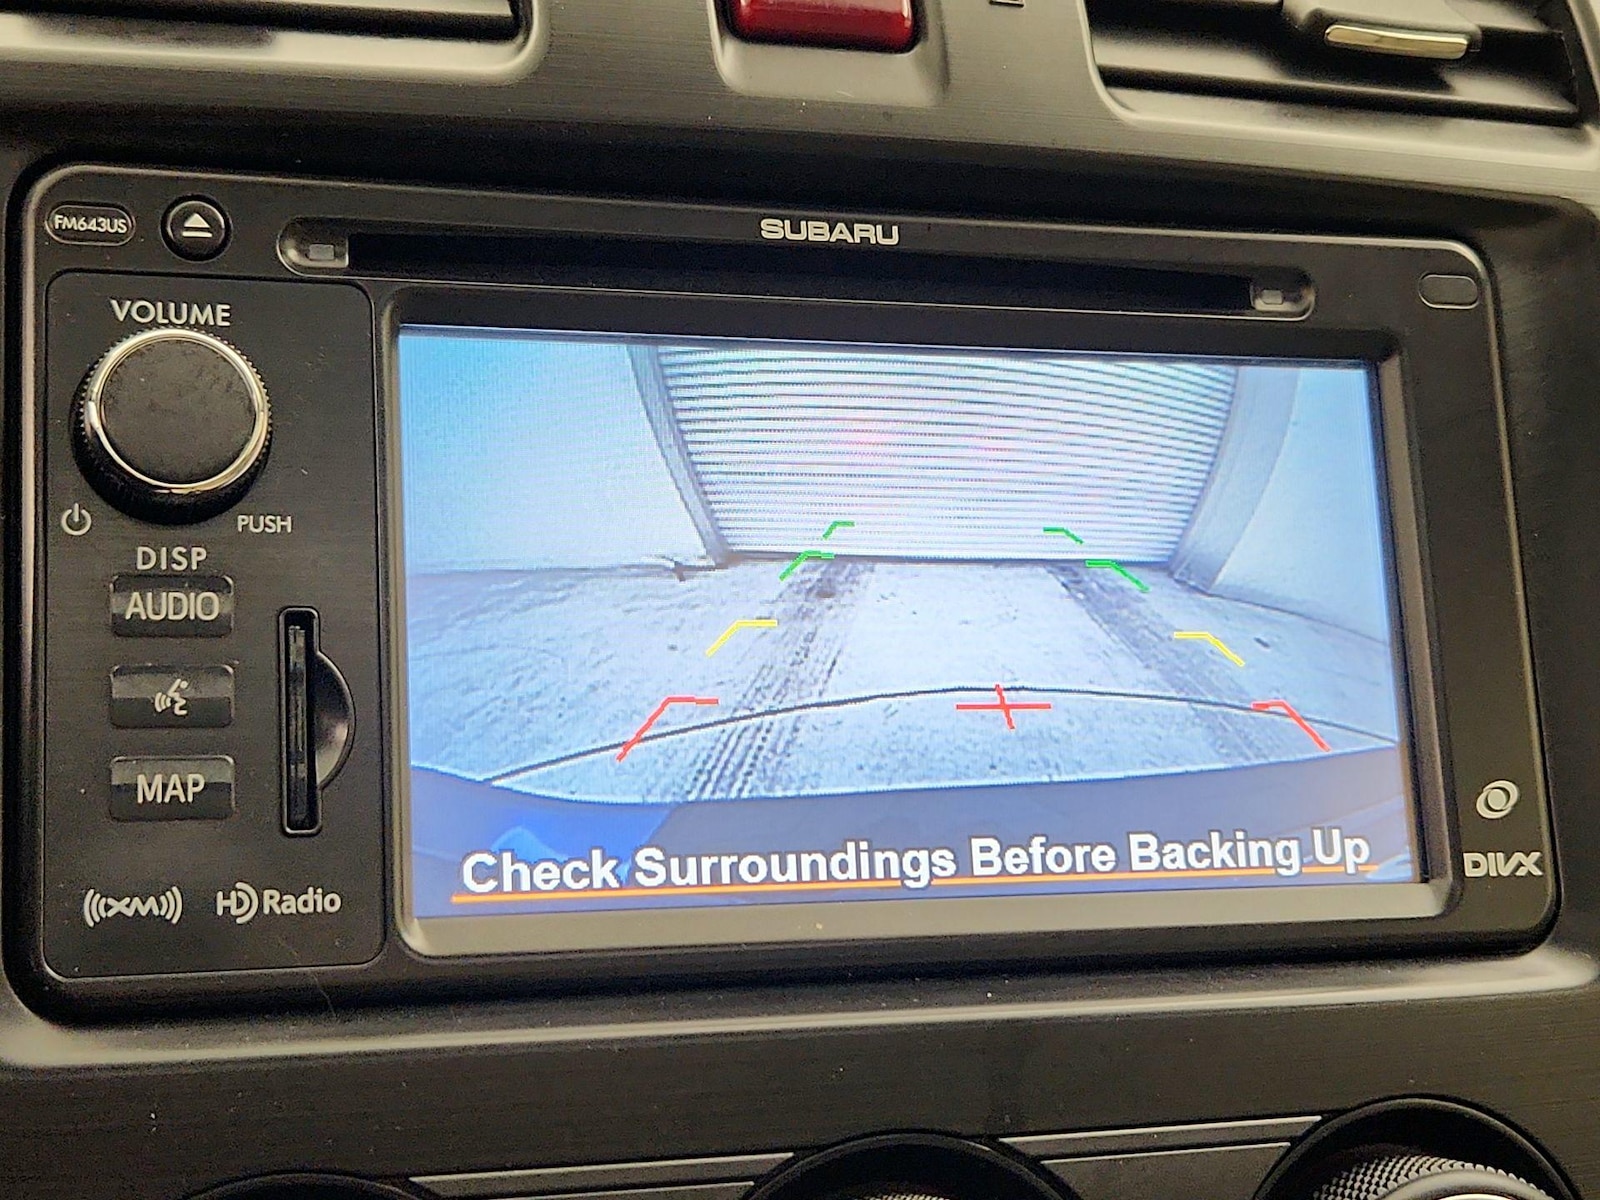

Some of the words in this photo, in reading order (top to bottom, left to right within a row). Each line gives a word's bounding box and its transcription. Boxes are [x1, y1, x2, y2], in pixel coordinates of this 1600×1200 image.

[54, 214, 129, 234] FM643US
[760, 218, 900, 245] SUBARU
[110, 299, 232, 327] VOLUME
[237, 514, 292, 534] PUSH
[136, 546, 207, 571] DISP
[125, 591, 220, 621] AUDIO
[136, 773, 206, 804] MAP
[462, 848, 620, 894] Check
[634, 840, 957, 888] Surroundings
[970, 835, 1117, 876] Before
[1128, 829, 1300, 876] Backing
[1312, 827, 1371, 874] Up
[216, 882, 259, 924] HD
[263, 886, 342, 915] Radio
